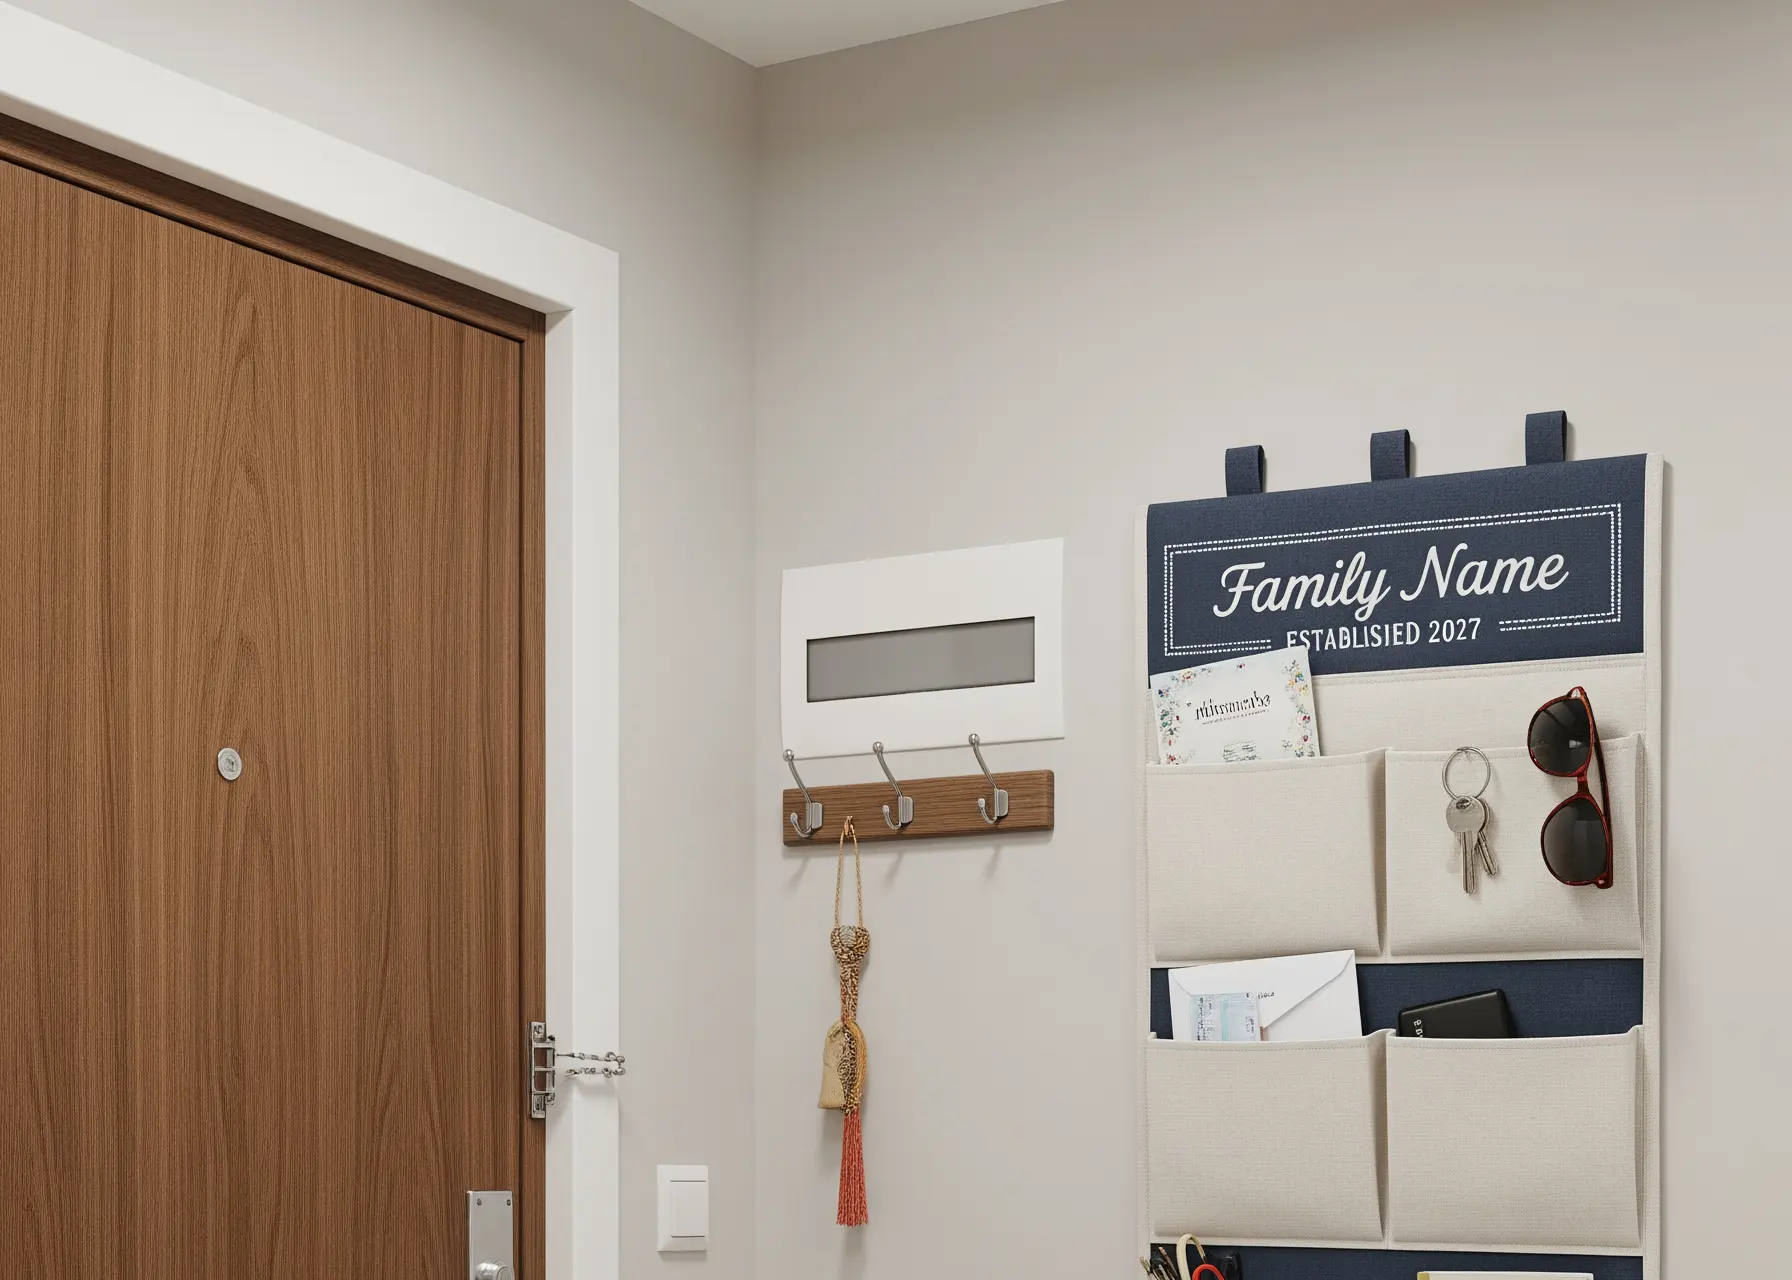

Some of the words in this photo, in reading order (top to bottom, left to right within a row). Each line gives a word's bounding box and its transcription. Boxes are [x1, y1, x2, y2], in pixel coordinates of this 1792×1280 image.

[1213, 551, 1391, 622] Family
[1400, 543, 1569, 601] Name
[1428, 617, 1481, 643] 2027
